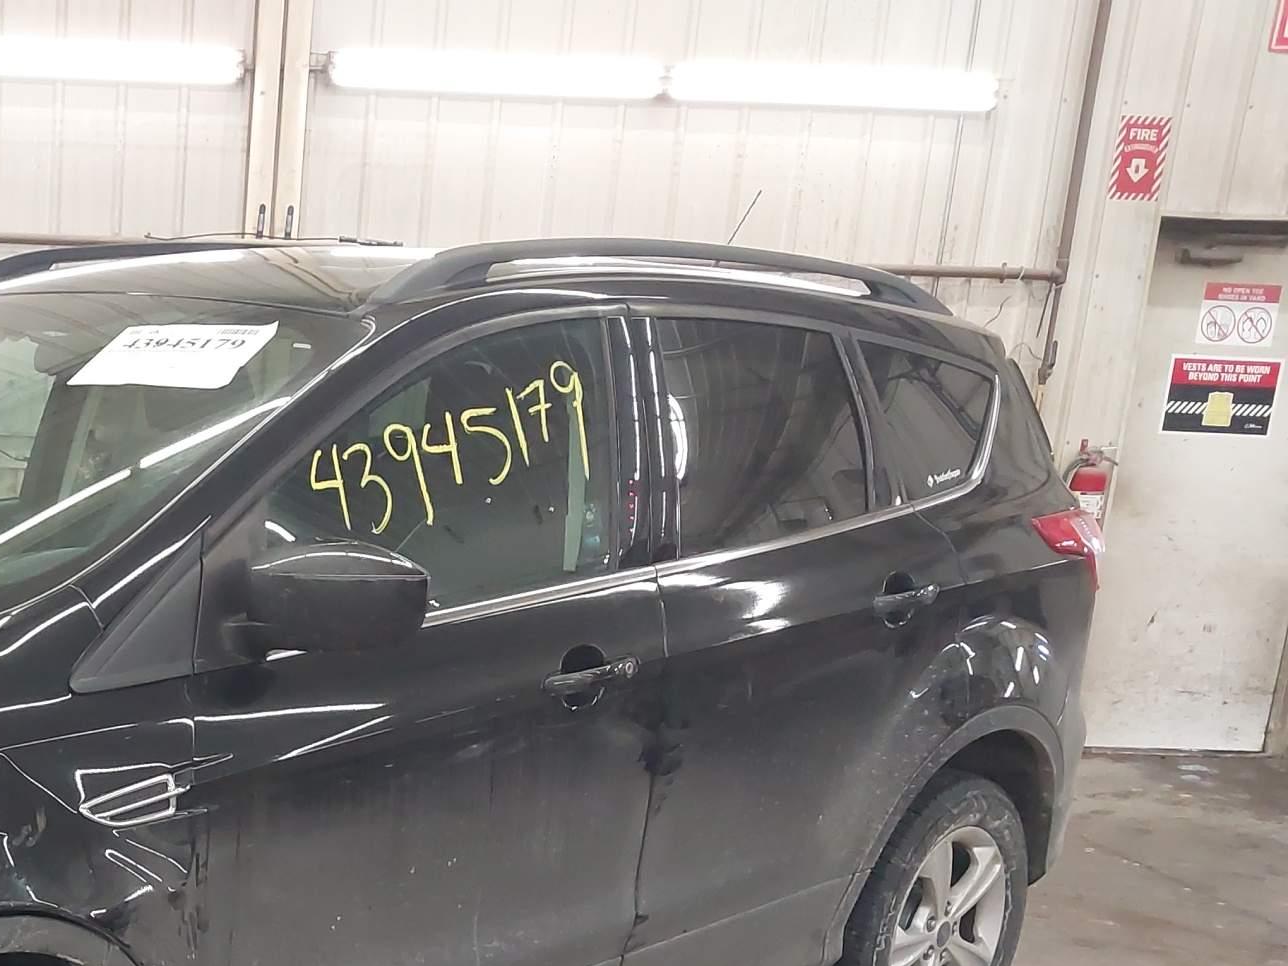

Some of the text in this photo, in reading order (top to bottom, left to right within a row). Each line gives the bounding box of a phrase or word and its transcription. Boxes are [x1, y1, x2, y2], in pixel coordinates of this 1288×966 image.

[1129, 128, 1159, 141] FIRE
[123, 338, 246, 349] 43945179
[1183, 362, 1271, 374] VESTS ARE TO BE WORN
[1188, 371, 1263, 383] BEYOND THIS POINT
[310, 360, 589, 535] 43945179
